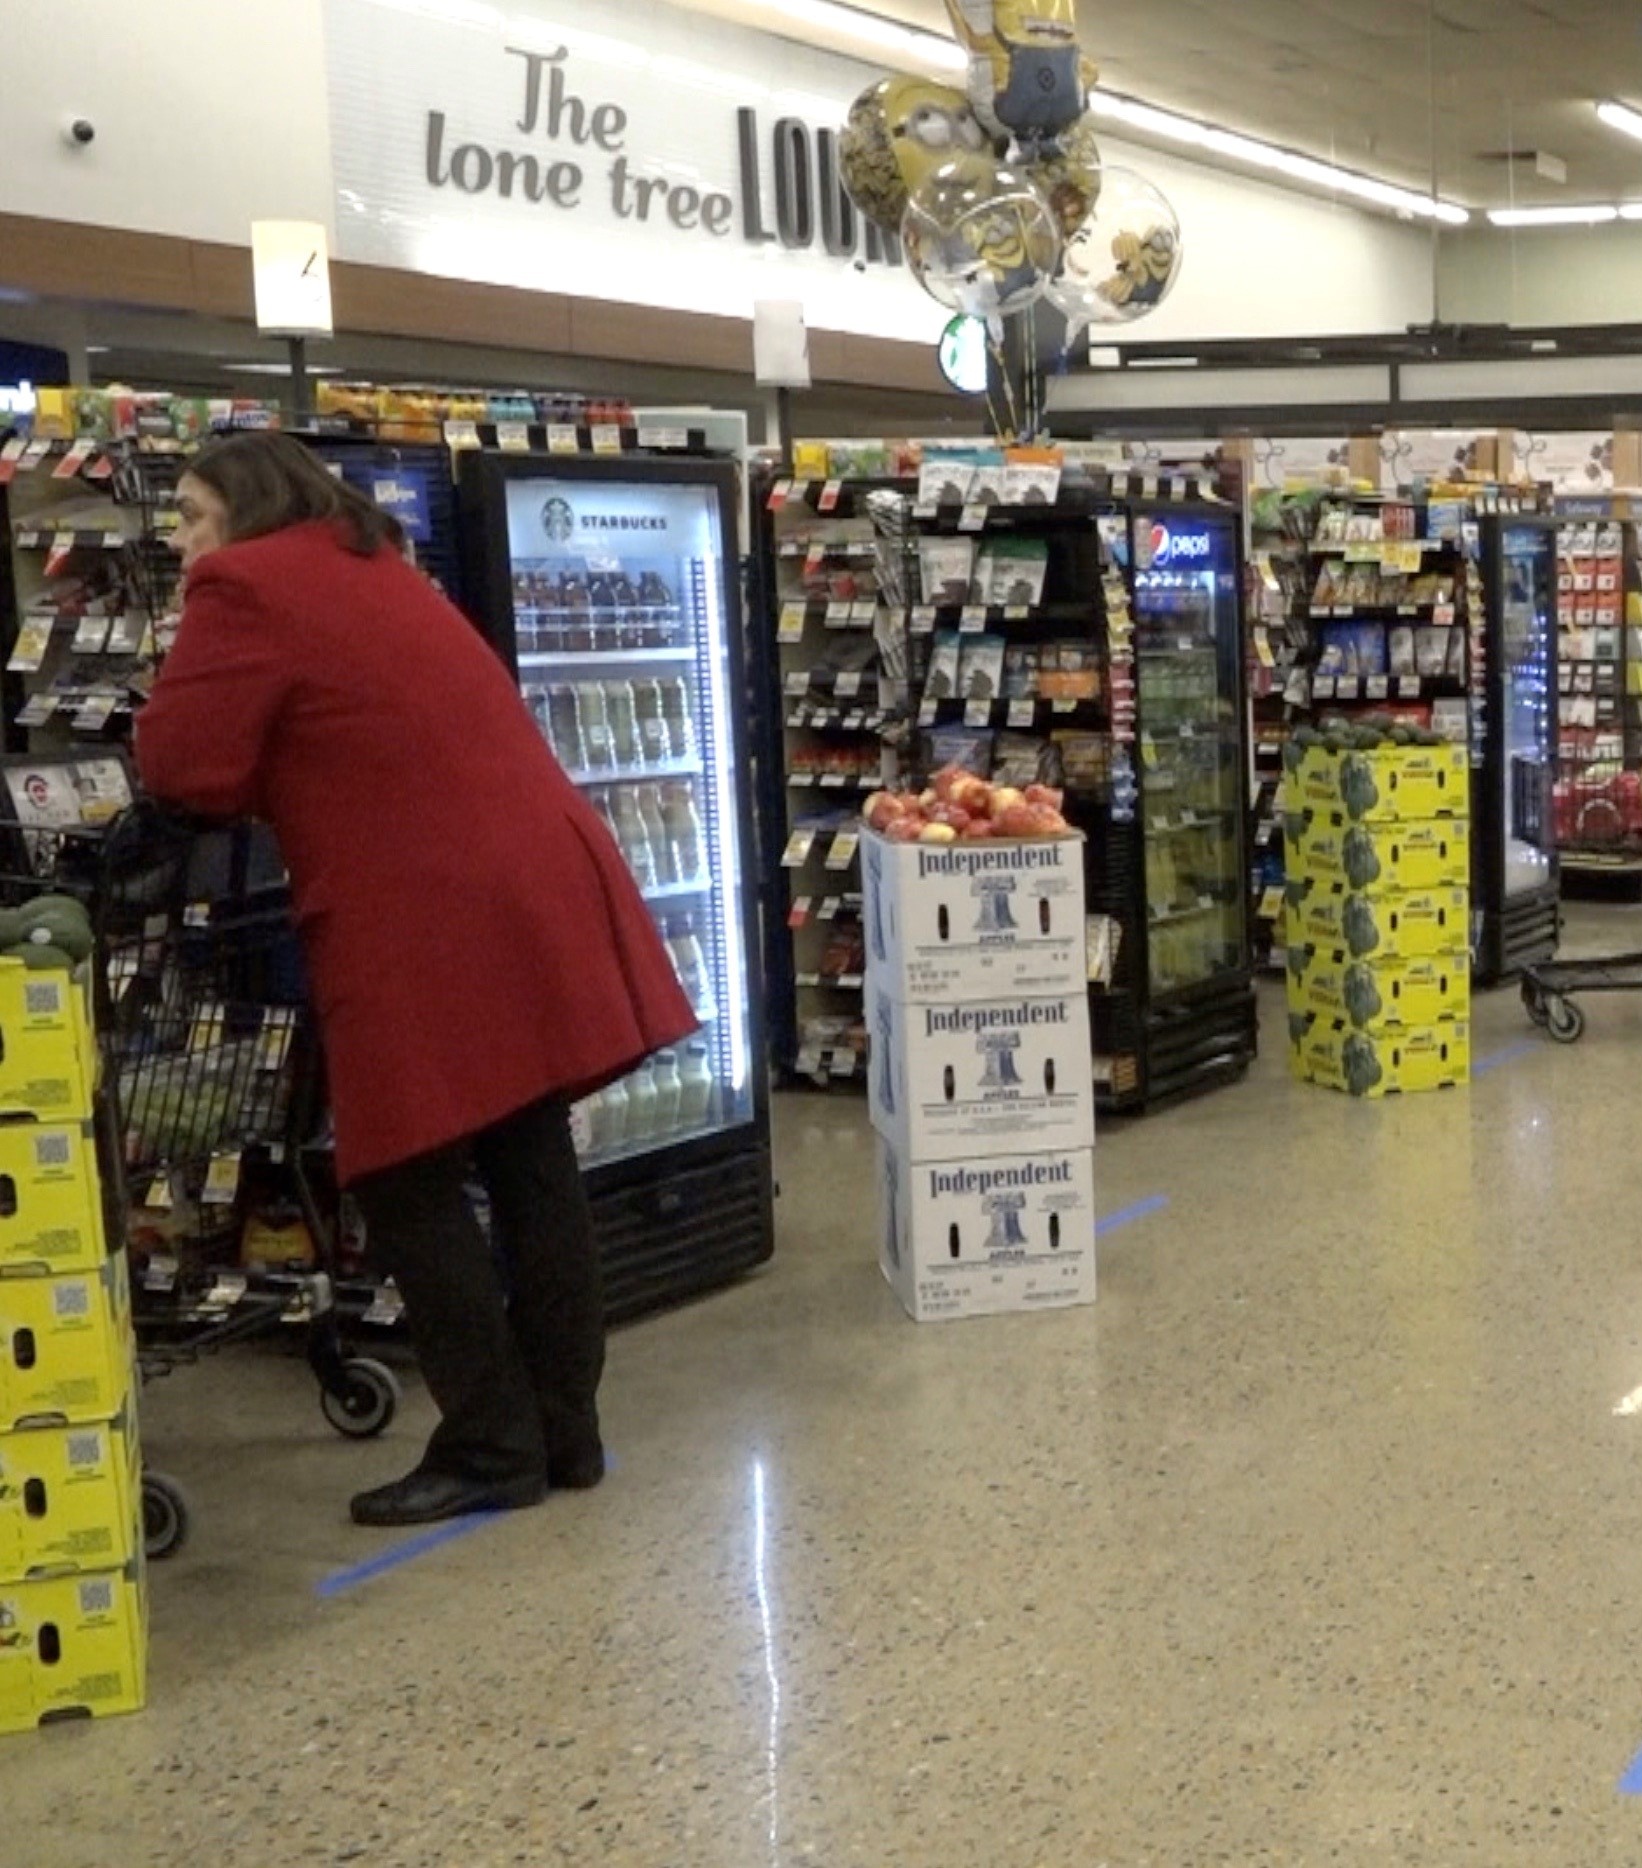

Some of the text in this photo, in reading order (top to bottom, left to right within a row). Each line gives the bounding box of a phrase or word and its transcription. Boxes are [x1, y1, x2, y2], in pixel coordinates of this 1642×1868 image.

[505, 44, 628, 150] The
[424, 110, 733, 236] lone tree
[580, 513, 668, 531] STARBUCKS
[1170, 529, 1210, 558] pepsi
[918, 844, 1064, 879] Independent
[926, 1001, 1069, 1037] Independent
[929, 1158, 1073, 1199] Independent
